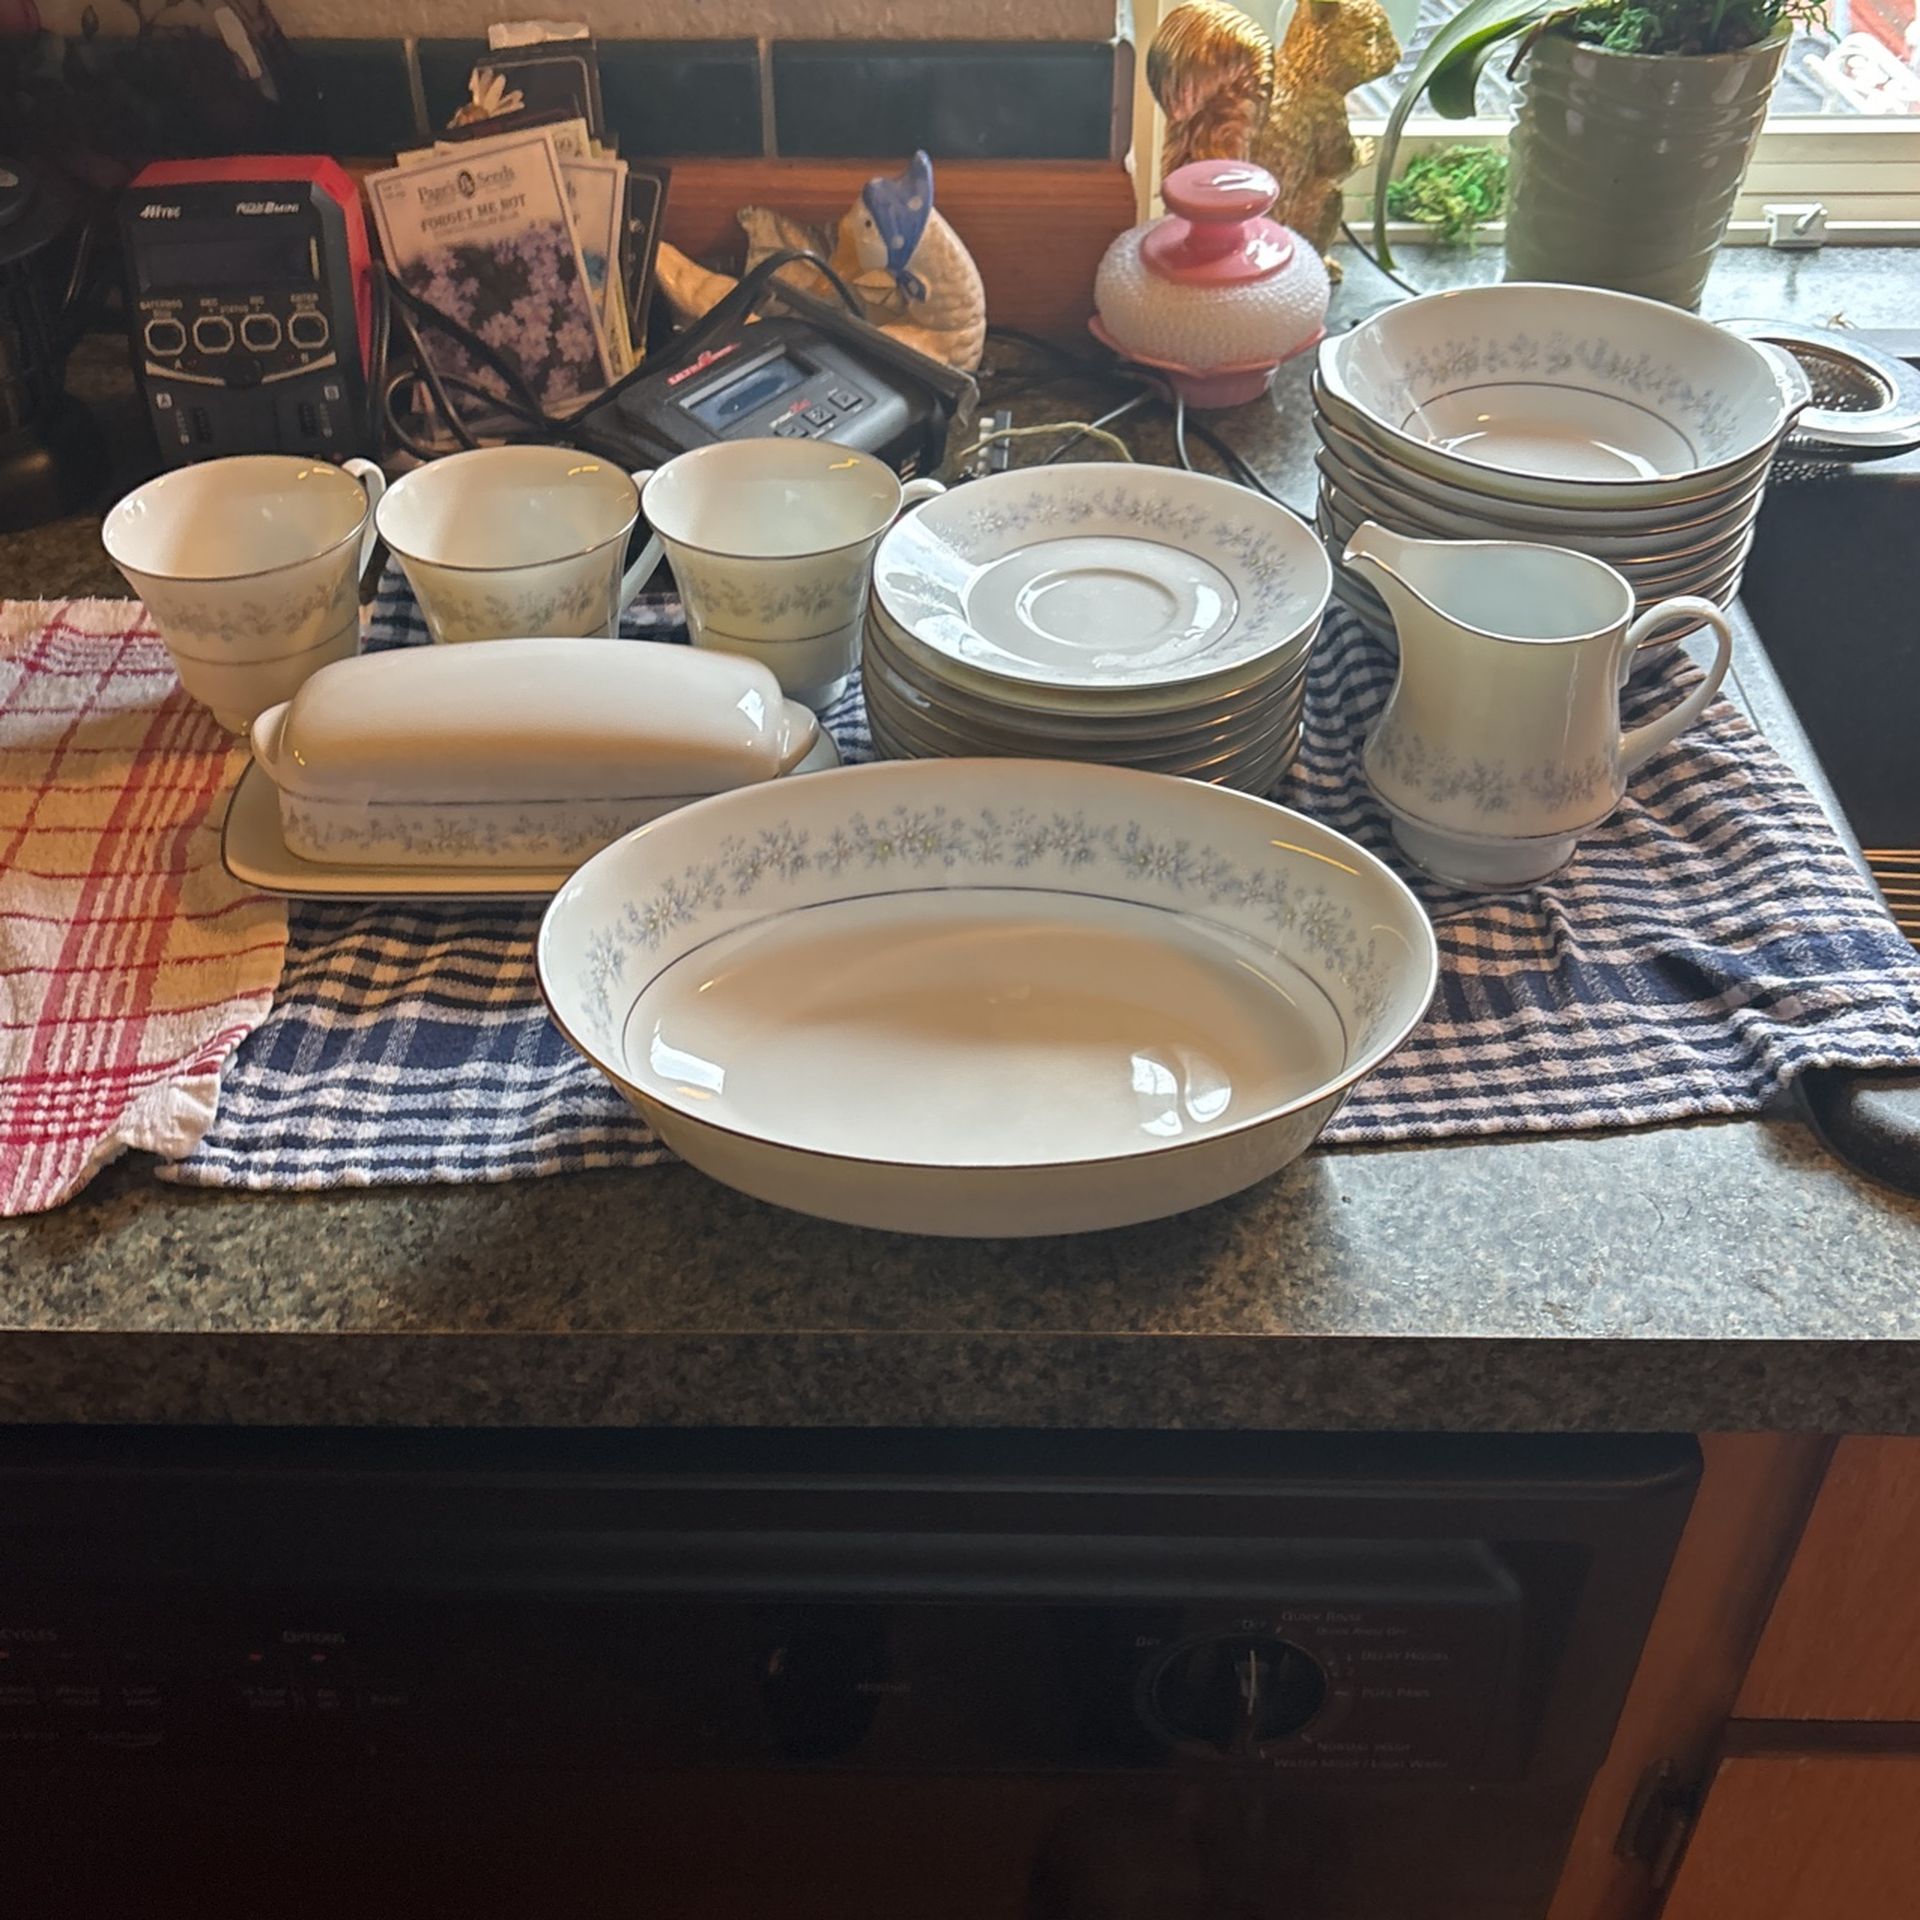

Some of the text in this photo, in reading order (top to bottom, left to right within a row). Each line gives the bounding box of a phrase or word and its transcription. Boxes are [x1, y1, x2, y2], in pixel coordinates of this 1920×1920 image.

[420, 207, 473, 232] FORGET
[476, 202, 498, 216] ME
[500, 192, 526, 210] NOT
